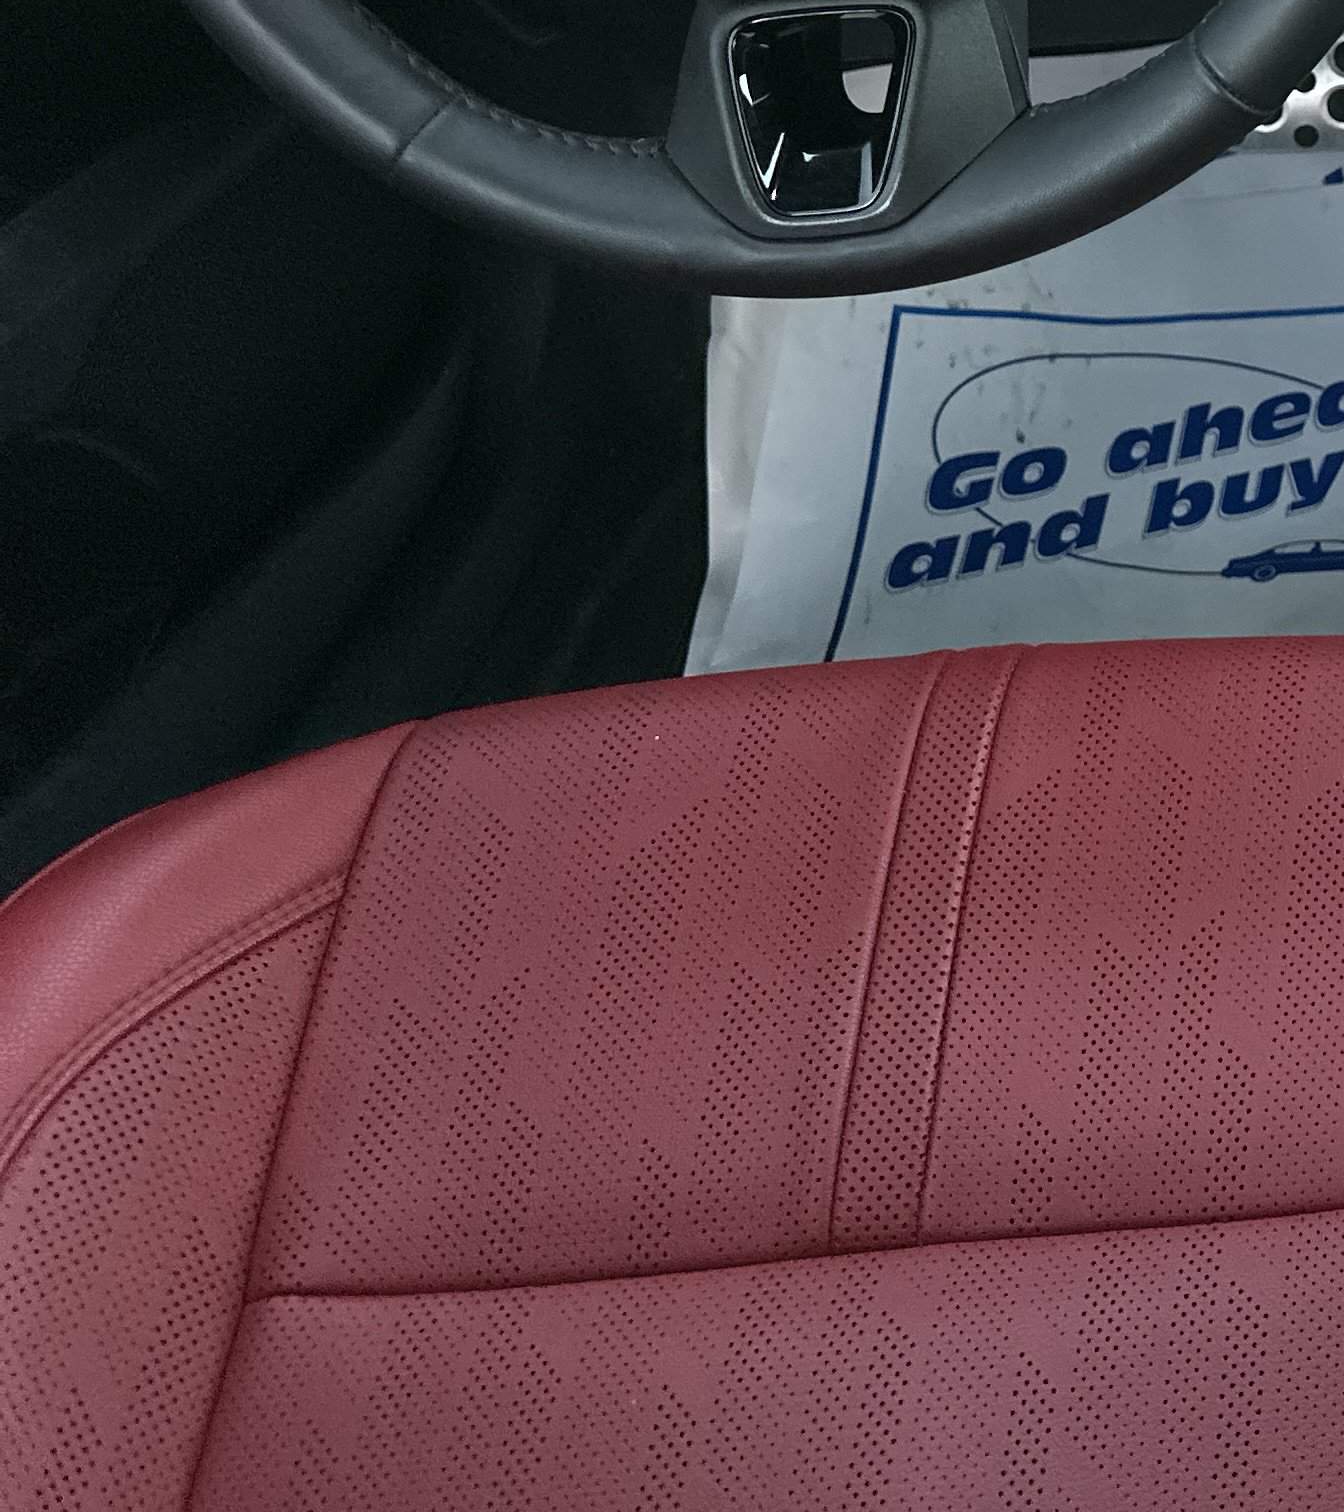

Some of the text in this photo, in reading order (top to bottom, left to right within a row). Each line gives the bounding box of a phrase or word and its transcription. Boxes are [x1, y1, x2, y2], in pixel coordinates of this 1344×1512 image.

[884, 492, 1111, 595] and
[1143, 449, 1344, 538] buy
[925, 445, 1069, 516] Go
